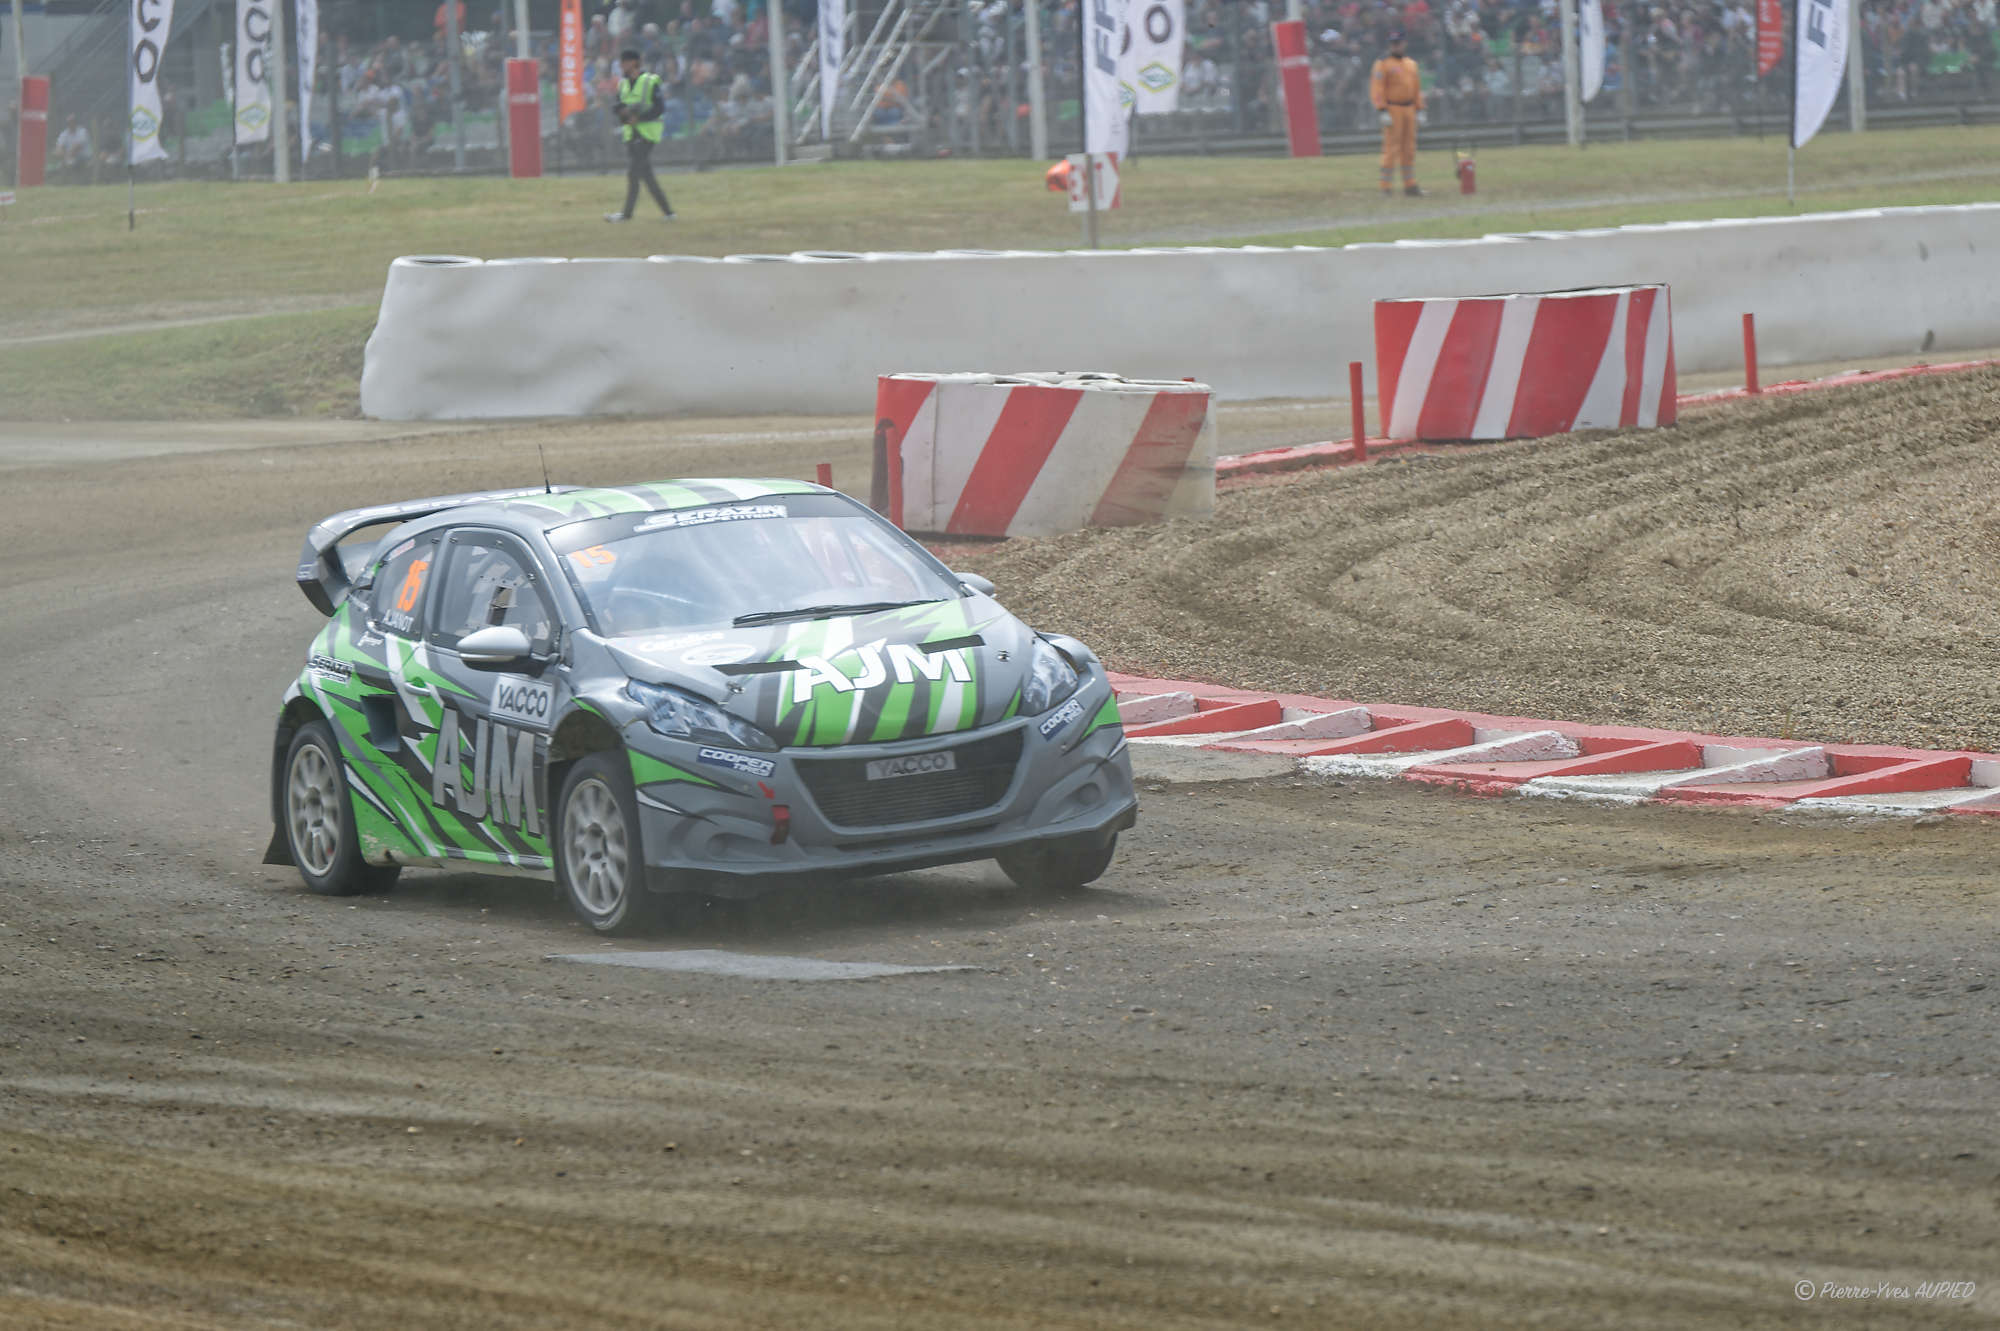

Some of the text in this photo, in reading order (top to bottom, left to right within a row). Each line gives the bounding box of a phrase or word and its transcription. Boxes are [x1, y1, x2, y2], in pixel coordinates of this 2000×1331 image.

[570, 545, 616, 568] 15
[397, 560, 428, 612] 15
[793, 637, 973, 703] AJM
[498, 684, 549, 717] YACCO
[1040, 699, 1081, 735] COOPER
[432, 706, 543, 837] AJM
[700, 748, 776, 772] COOPER
[877, 754, 948, 778] YACCO
